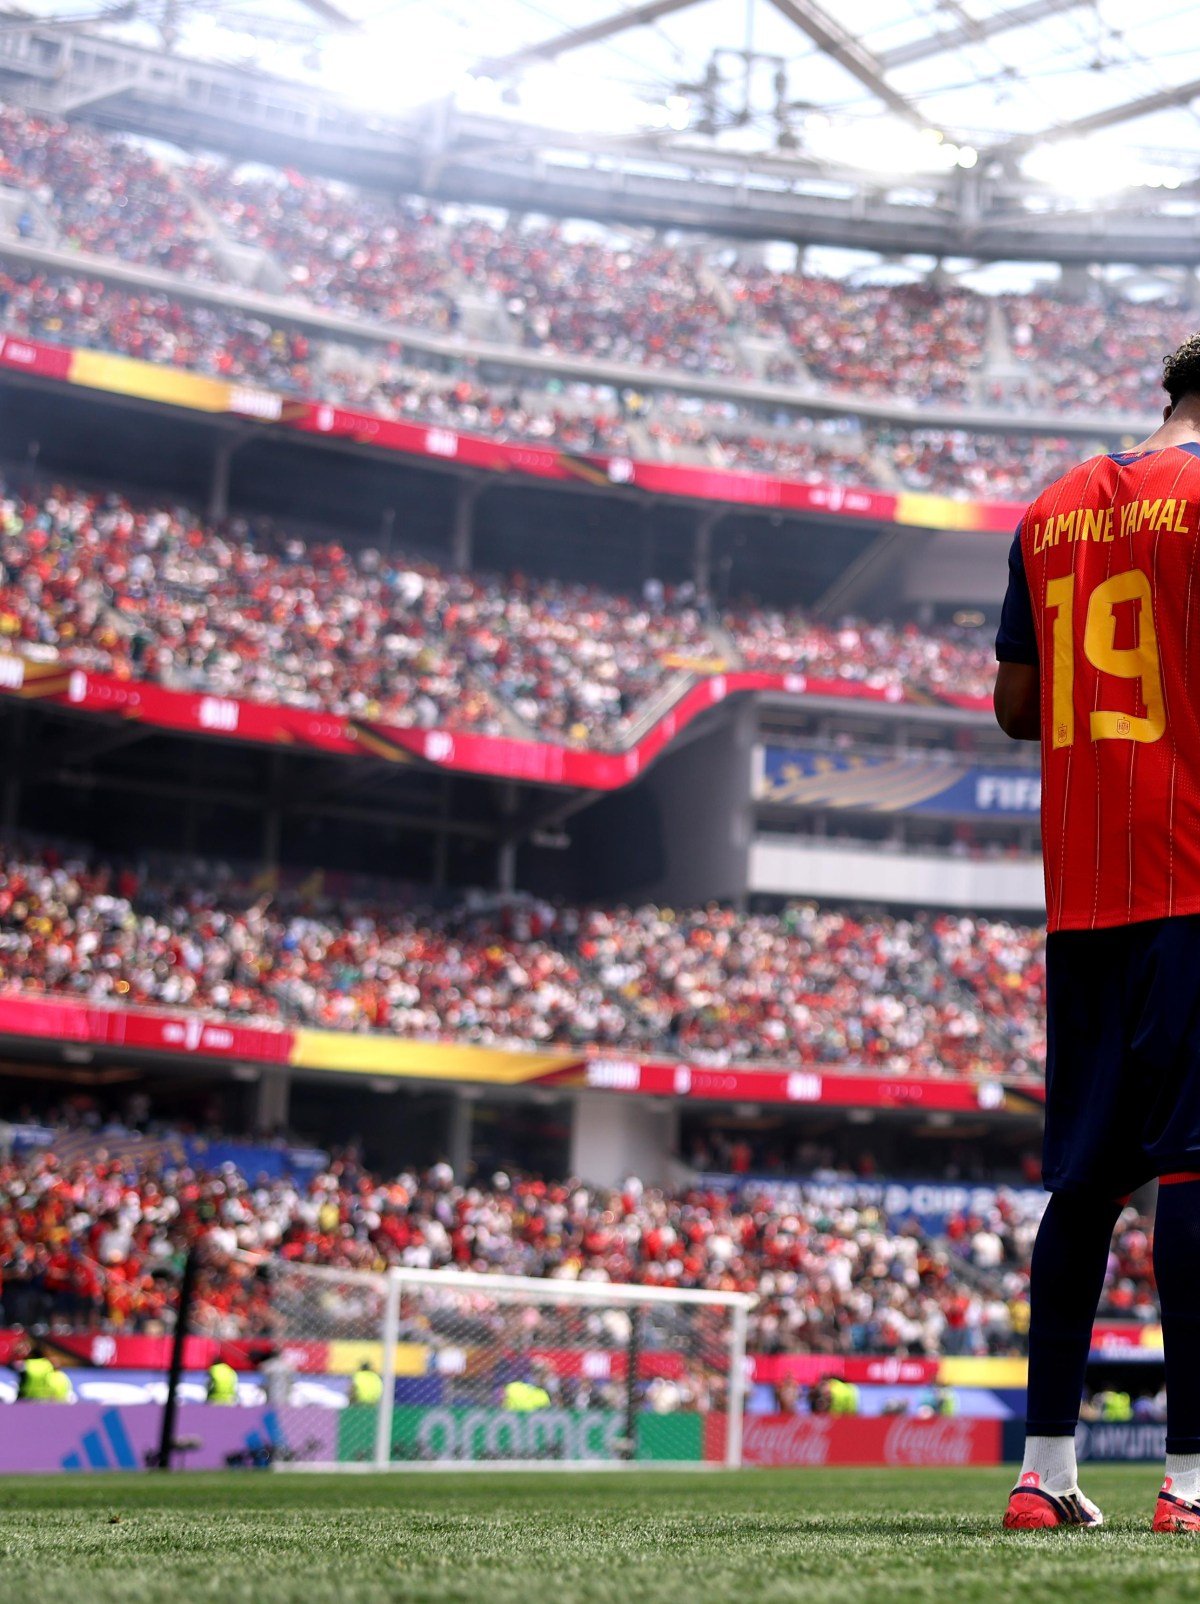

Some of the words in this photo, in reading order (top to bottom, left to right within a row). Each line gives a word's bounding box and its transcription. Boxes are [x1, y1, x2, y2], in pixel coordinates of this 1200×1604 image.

[1033, 507, 1115, 556] LAMINE
[1119, 498, 1189, 538] YAMAL
[1045, 568, 1167, 750] 19
